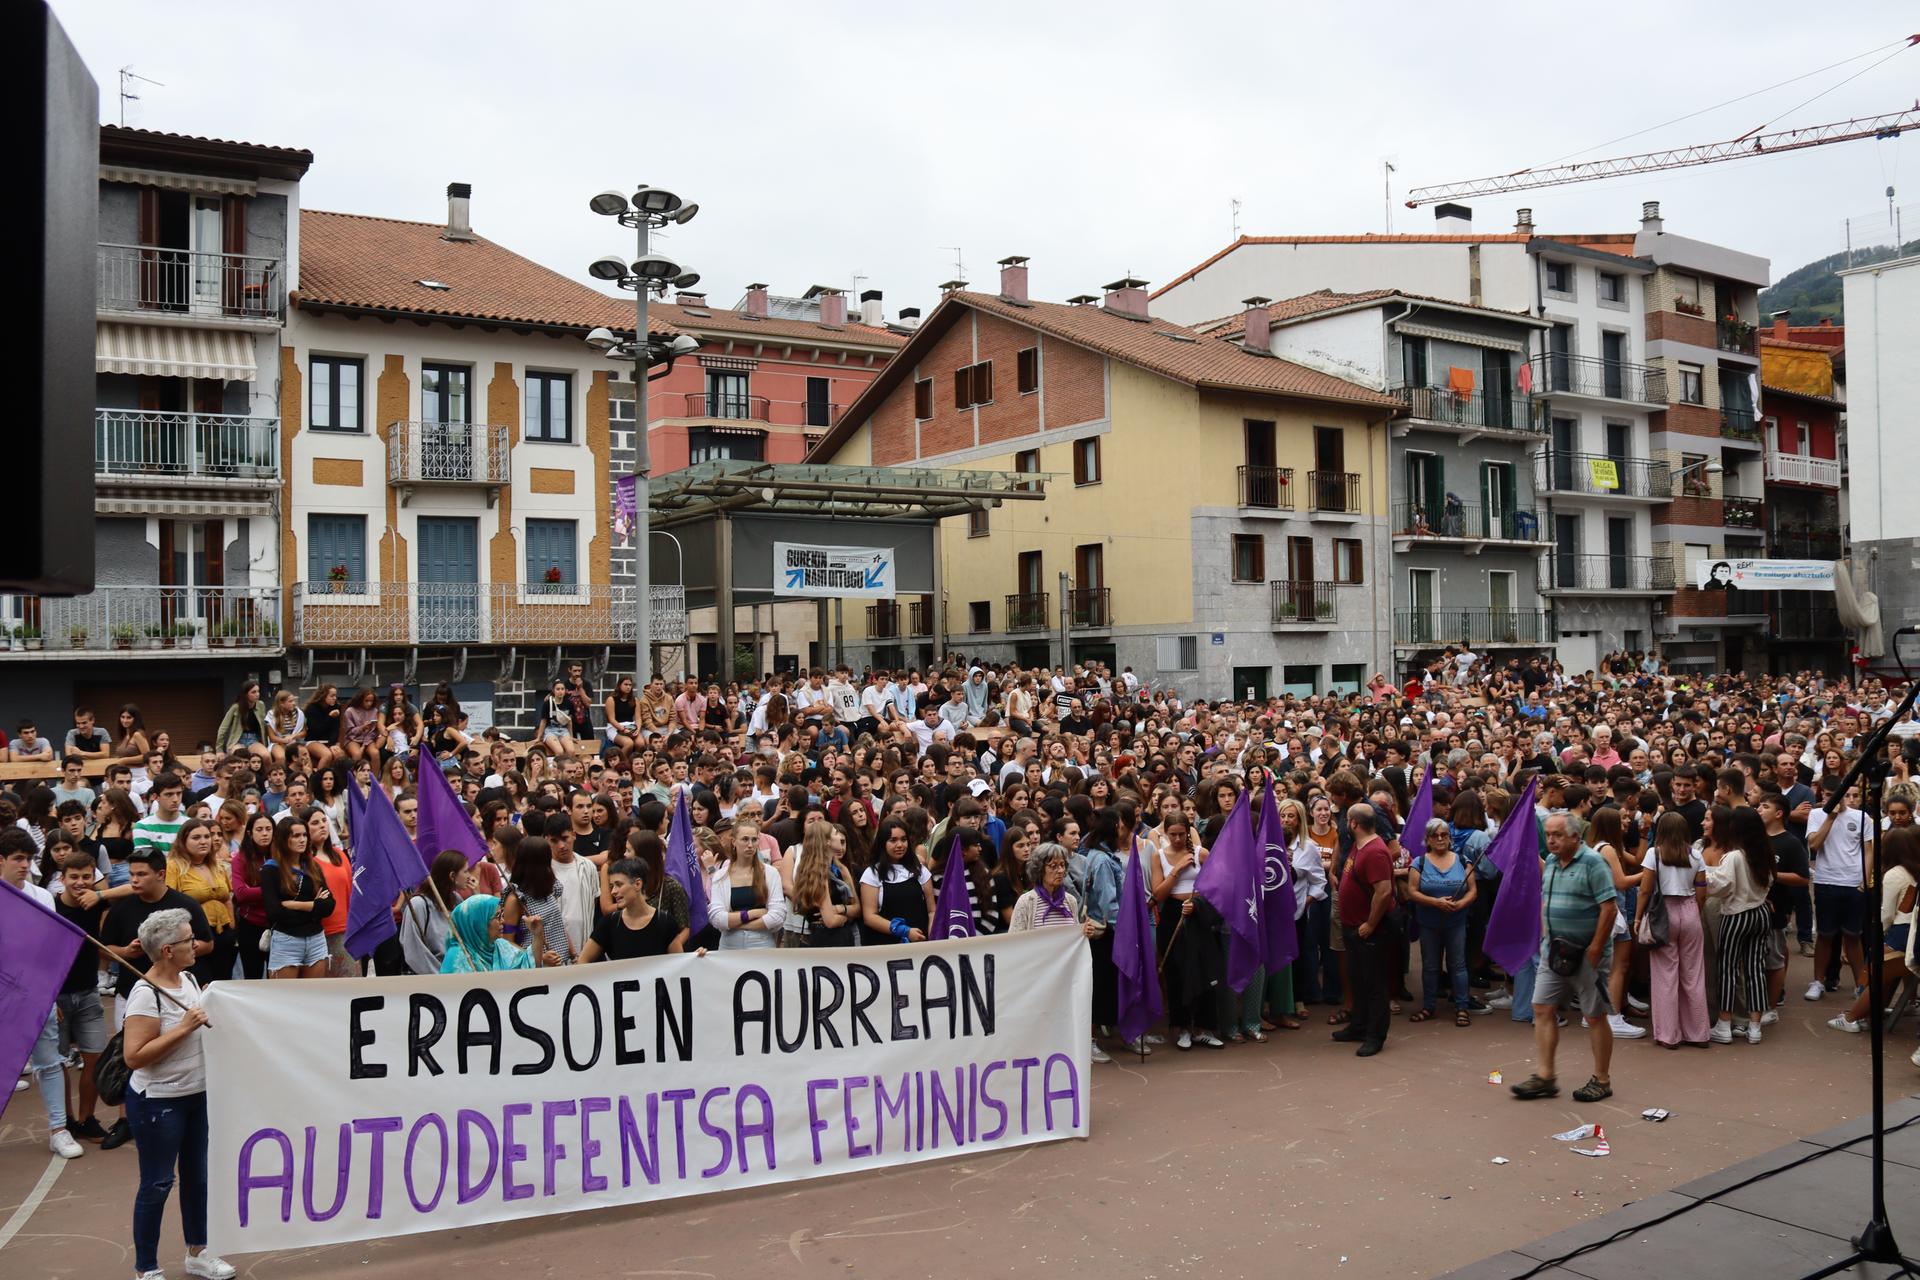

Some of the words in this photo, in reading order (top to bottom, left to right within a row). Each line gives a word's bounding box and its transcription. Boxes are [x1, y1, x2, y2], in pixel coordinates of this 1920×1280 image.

[786, 549, 828, 568] GUREKIN
[804, 569, 827, 587] NAHI
[828, 569, 864, 589] DITUGU
[843, 694, 855, 708] 89
[350, 976, 693, 1080] ERASOEN
[733, 953, 996, 1056] AURREAN
[238, 1083, 777, 1227] AUTODEFENTSA
[806, 1052, 1081, 1165] FEMINISTA
